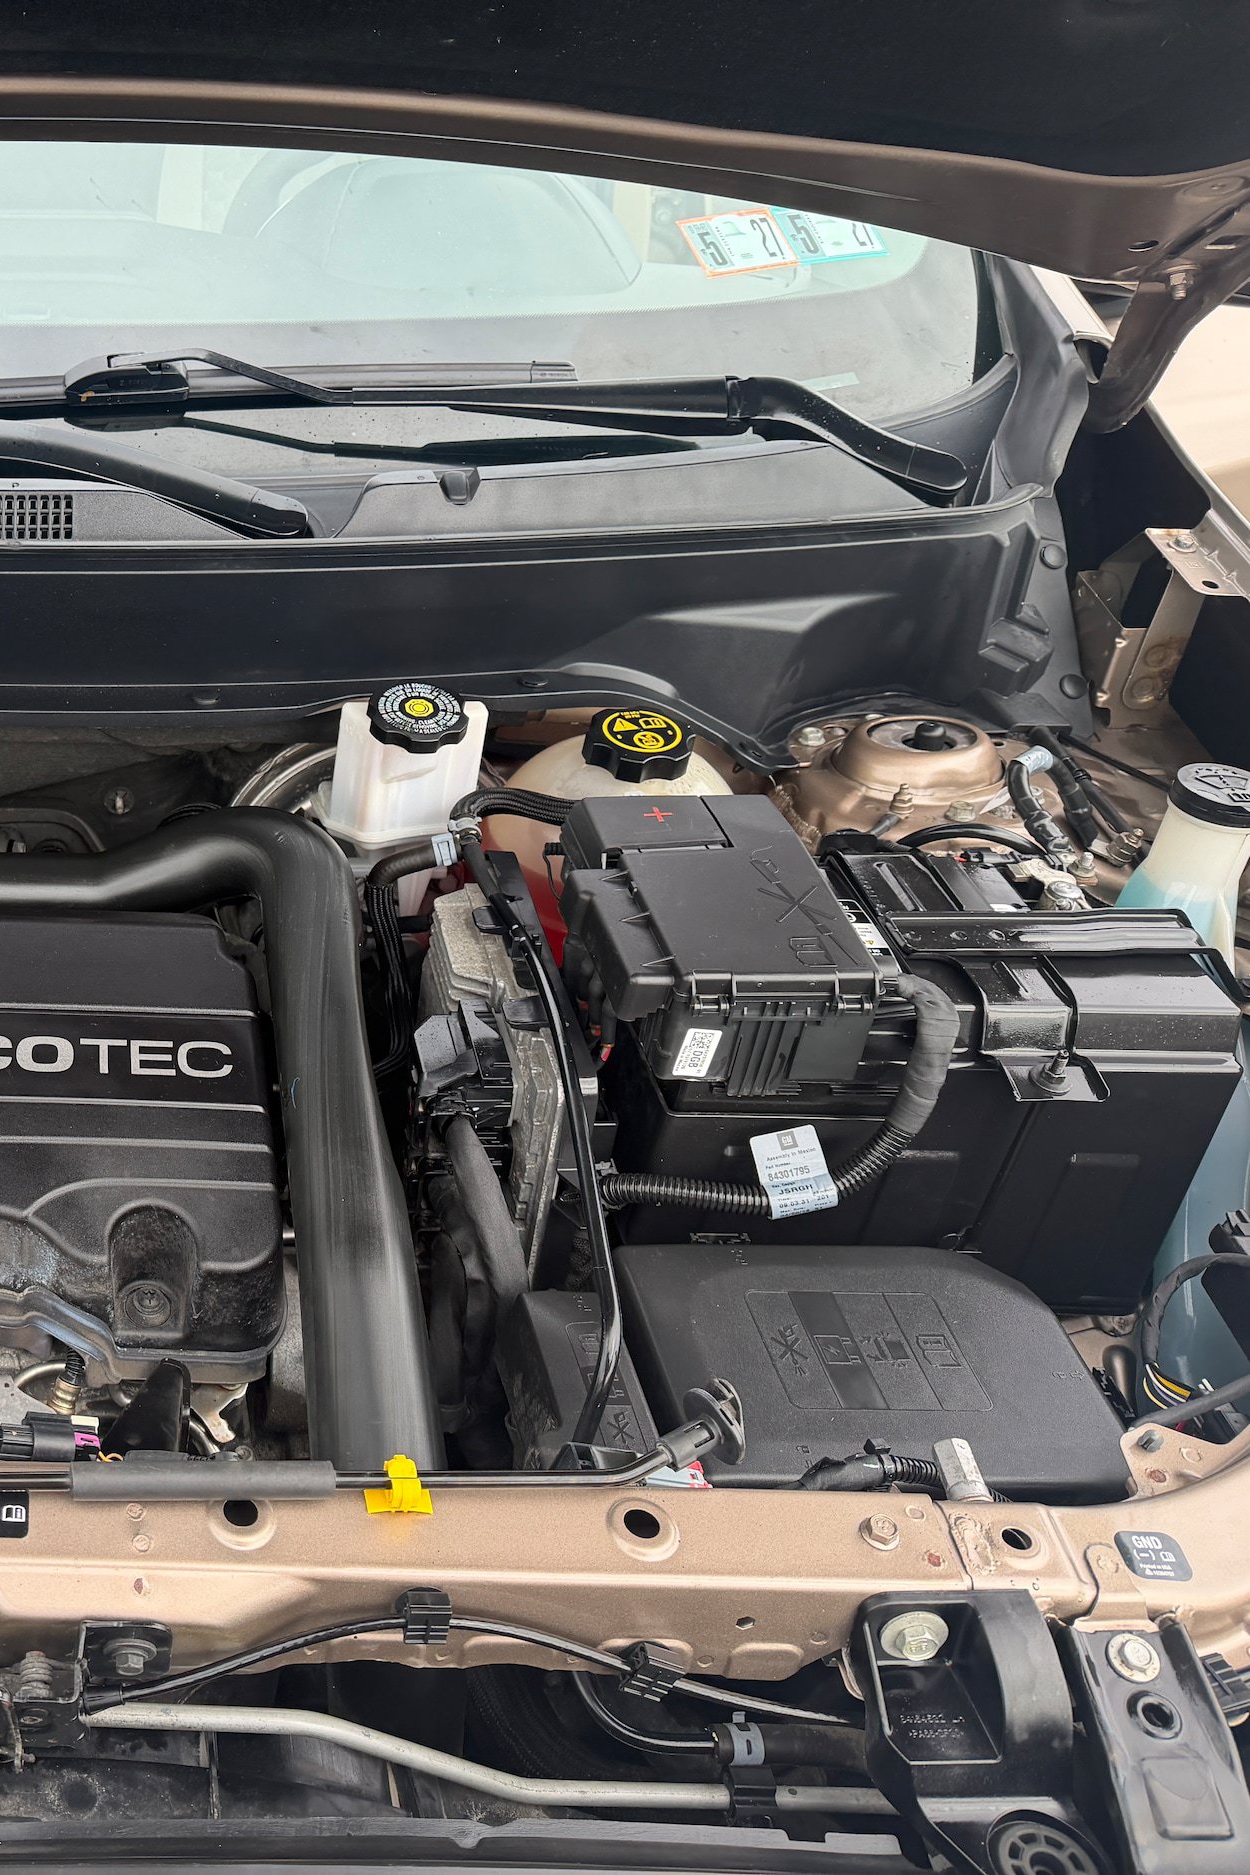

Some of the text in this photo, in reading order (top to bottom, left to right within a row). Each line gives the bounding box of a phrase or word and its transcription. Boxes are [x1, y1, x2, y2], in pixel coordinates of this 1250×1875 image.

[749, 217, 785, 257] 27
[786, 214, 820, 254] 5
[696, 231, 729, 266] 5
[688, 1050, 703, 1067] DGB
[781, 1134, 794, 1147] GM
[767, 1165, 810, 1182] 84301795
[1131, 1535, 1163, 1550] GND
